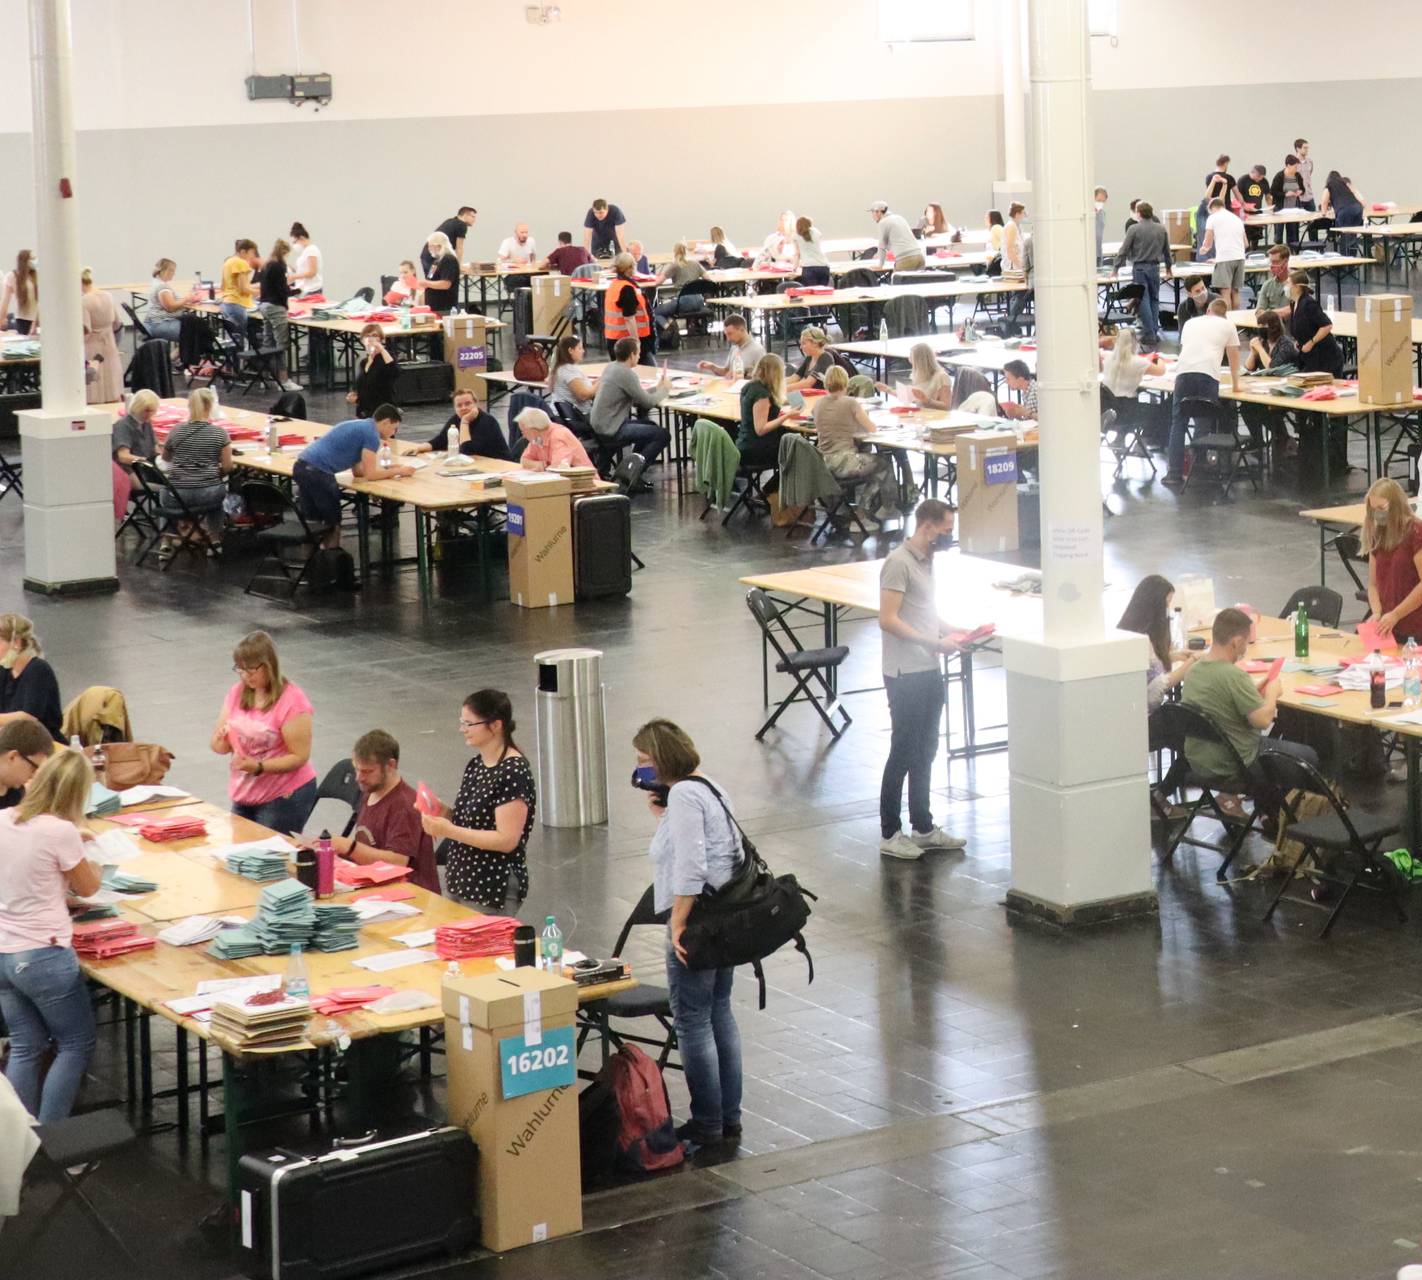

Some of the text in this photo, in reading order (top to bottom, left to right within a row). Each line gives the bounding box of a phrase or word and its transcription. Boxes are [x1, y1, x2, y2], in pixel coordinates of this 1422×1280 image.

[460, 352, 484, 361] 22205
[986, 461, 1015, 475] 18209
[507, 1044, 569, 1076] 16202
